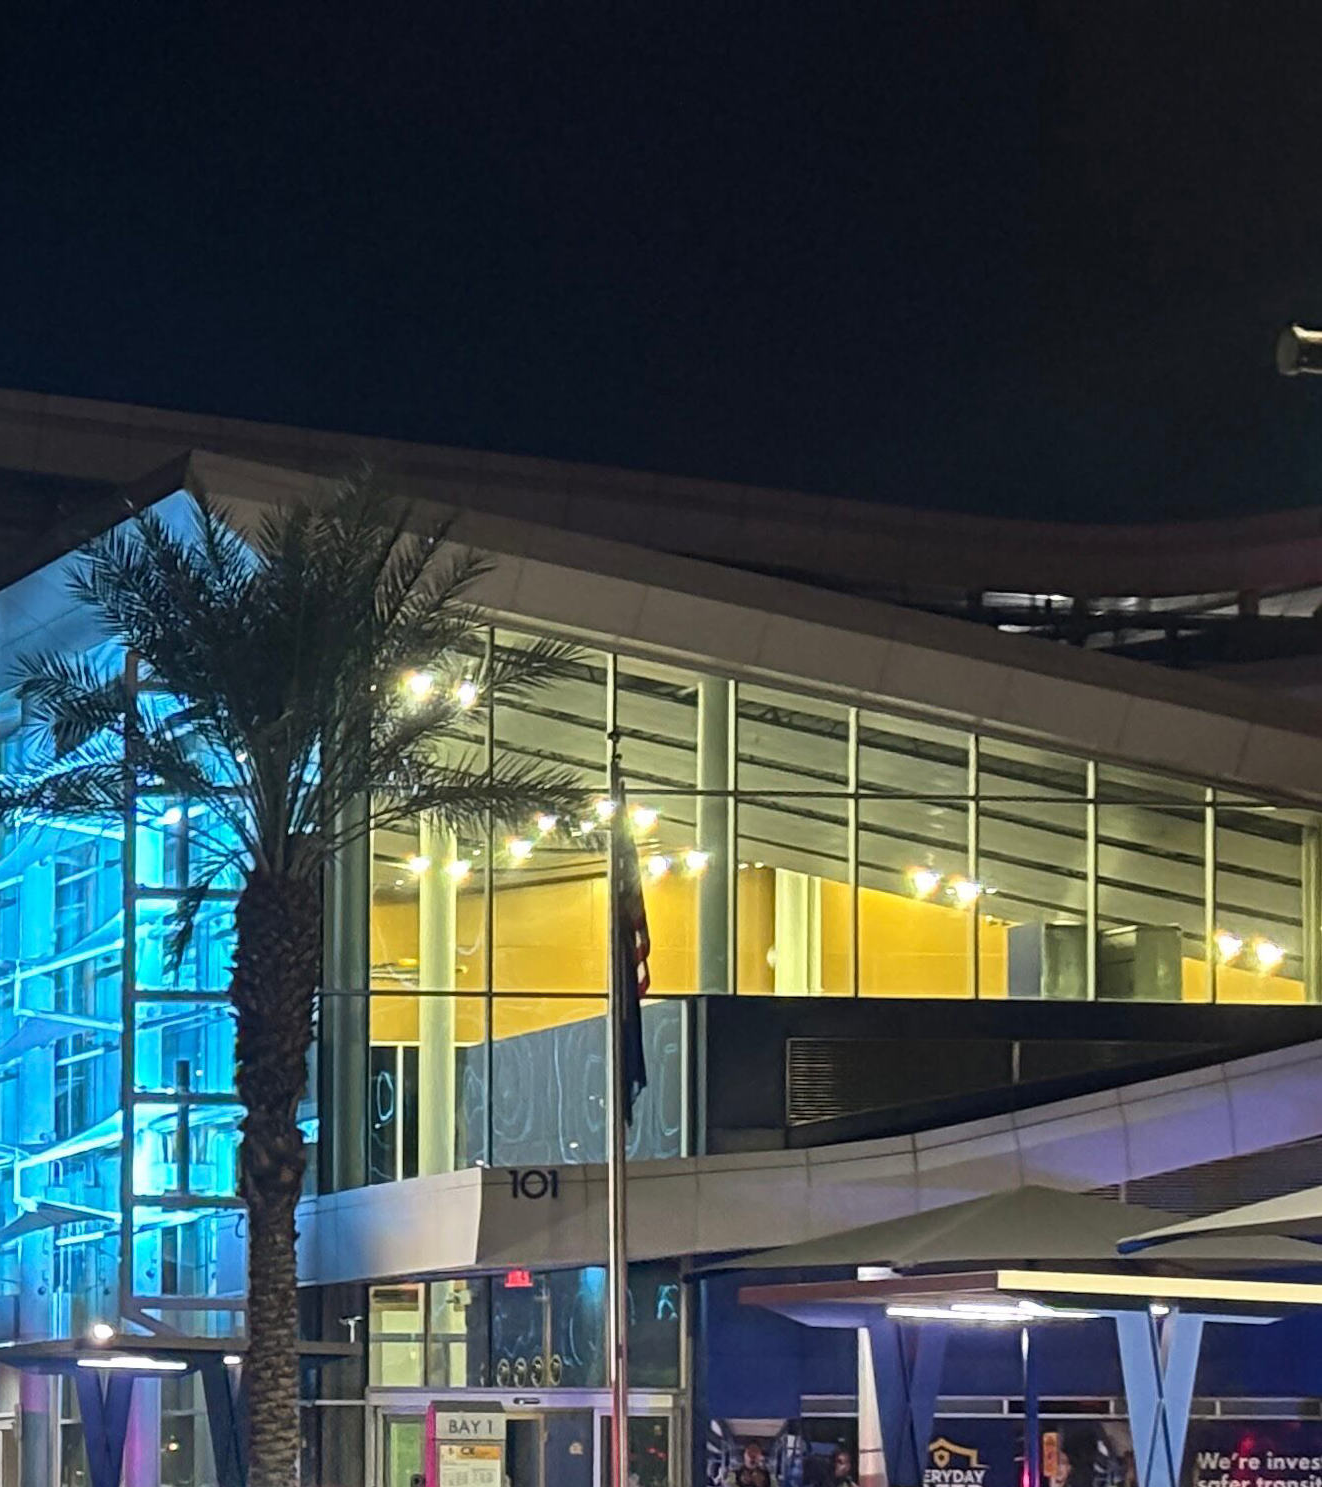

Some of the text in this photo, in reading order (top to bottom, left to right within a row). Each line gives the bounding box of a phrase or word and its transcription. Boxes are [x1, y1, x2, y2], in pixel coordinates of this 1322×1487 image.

[509, 1170, 559, 1199] 101
[448, 1420, 493, 1434] BAY 1
[1197, 1451, 1322, 1470] We're inves
[924, 1469, 987, 1484] ERYDAY
